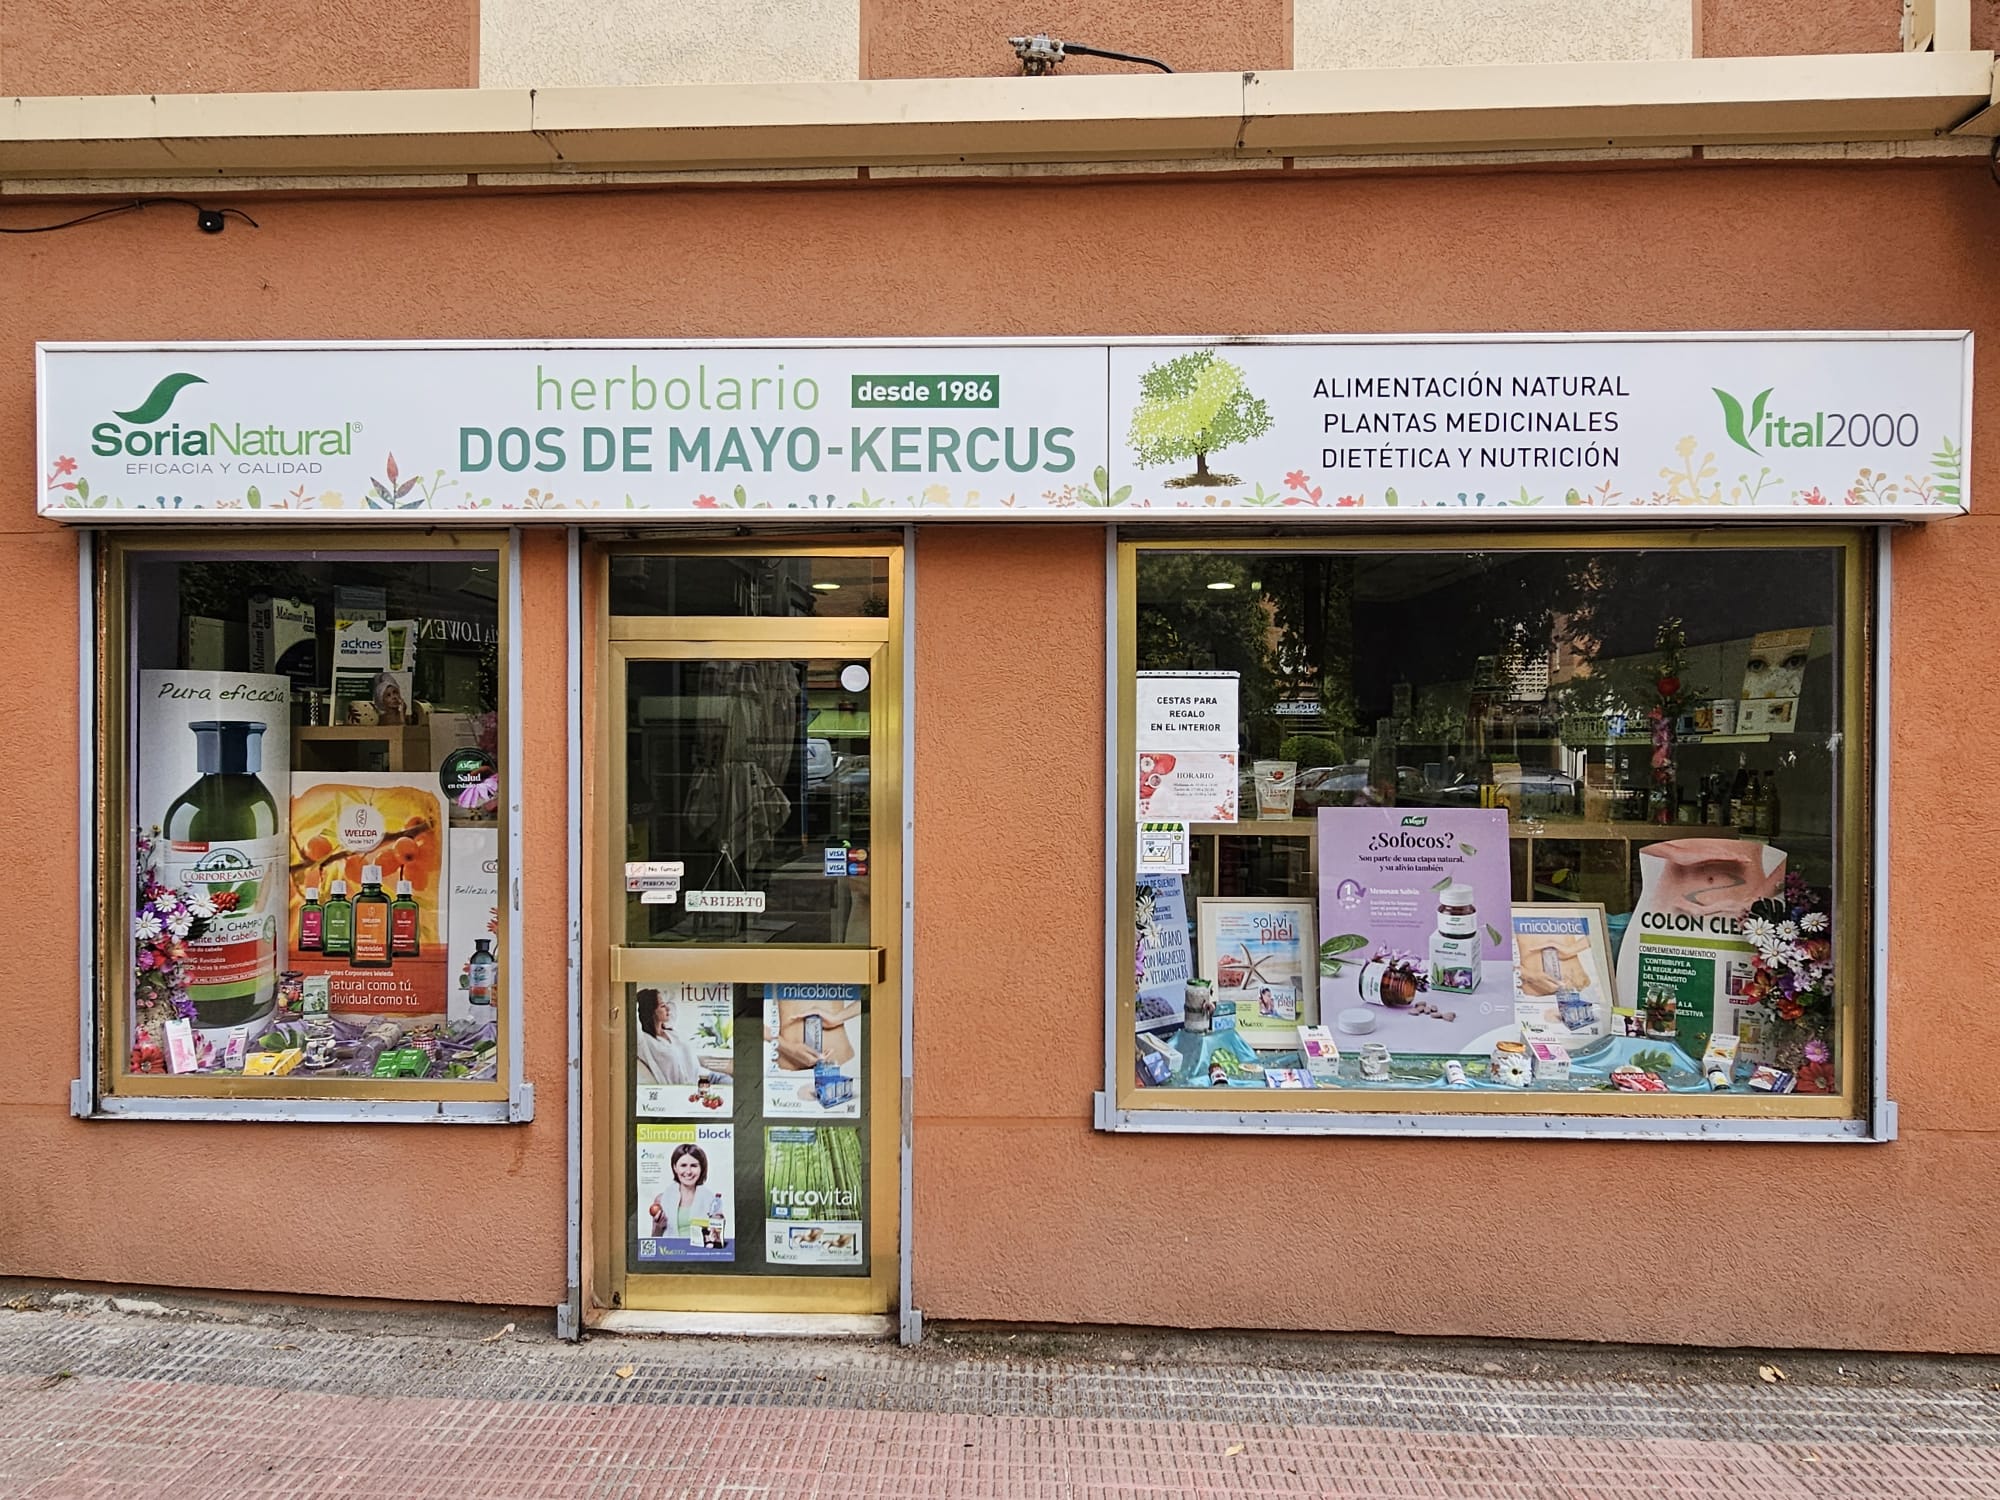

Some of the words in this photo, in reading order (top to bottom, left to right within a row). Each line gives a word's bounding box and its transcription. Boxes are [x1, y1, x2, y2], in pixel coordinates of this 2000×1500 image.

[537, 365, 819, 410] herbolario
[858, 382, 930, 401] desde
[937, 382, 993, 401] 1986
[1313, 371, 1502, 398] ALIMENTACIÓN
[1512, 376, 1629, 397] NATURAL
[1324, 413, 1437, 433] PLANTAS
[1446, 412, 1619, 432] MEDICINALES
[1711, 387, 1919, 457] Vital2000
[460, 427, 567, 472] DOS
[583, 427, 652, 472] DE
[669, 427, 1075, 472] MAYO-KERCUS
[1322, 442, 1450, 468] DIETÉTICA
[1458, 448, 1472, 467] Y
[1481, 441, 1619, 467] NUTRICIÓN
[126, 463, 213, 475] EFICACIA
[220, 463, 231, 474] Y
[238, 462, 322, 474] CALIDAD
[341, 638, 382, 649] acknes
[158, 683, 211, 700] Pura
[220, 684, 284, 703] eficacia
[1157, 696, 1191, 704] CESTAS
[1194, 696, 1218, 704] PARA
[1170, 710, 1205, 718] REGALO
[1178, 724, 1221, 732] INTERIOR
[457, 773, 480, 781] Salud
[1368, 832, 1454, 851] ¿Sofocos?
[1415, 864, 1444, 872] también
[184, 872, 232, 881] CORPORE
[698, 896, 762, 907] ABIERTO
[1519, 919, 1582, 934] micobiotic
[1641, 912, 1703, 932] COLON
[215, 933, 228, 942] del
[1262, 922, 1292, 945] piel
[1639, 945, 1680, 956] COMPLEMENTO
[1681, 950, 1716, 958] ALIMENTICIO
[1652, 967, 1696, 976] REGULARIDAD
[1656, 974, 1687, 983] TRÁNSITO
[367, 982, 396, 991] como
[399, 979, 413, 991] tú.
[681, 982, 730, 1002] ituvit
[784, 984, 853, 999] micobiotic
[330, 993, 371, 1005] dividual
[374, 996, 402, 1005] como
[406, 994, 420, 1005] tú.
[640, 1126, 694, 1140] Slimform
[698, 1128, 731, 1140] block
[770, 1185, 856, 1206] tricovital
